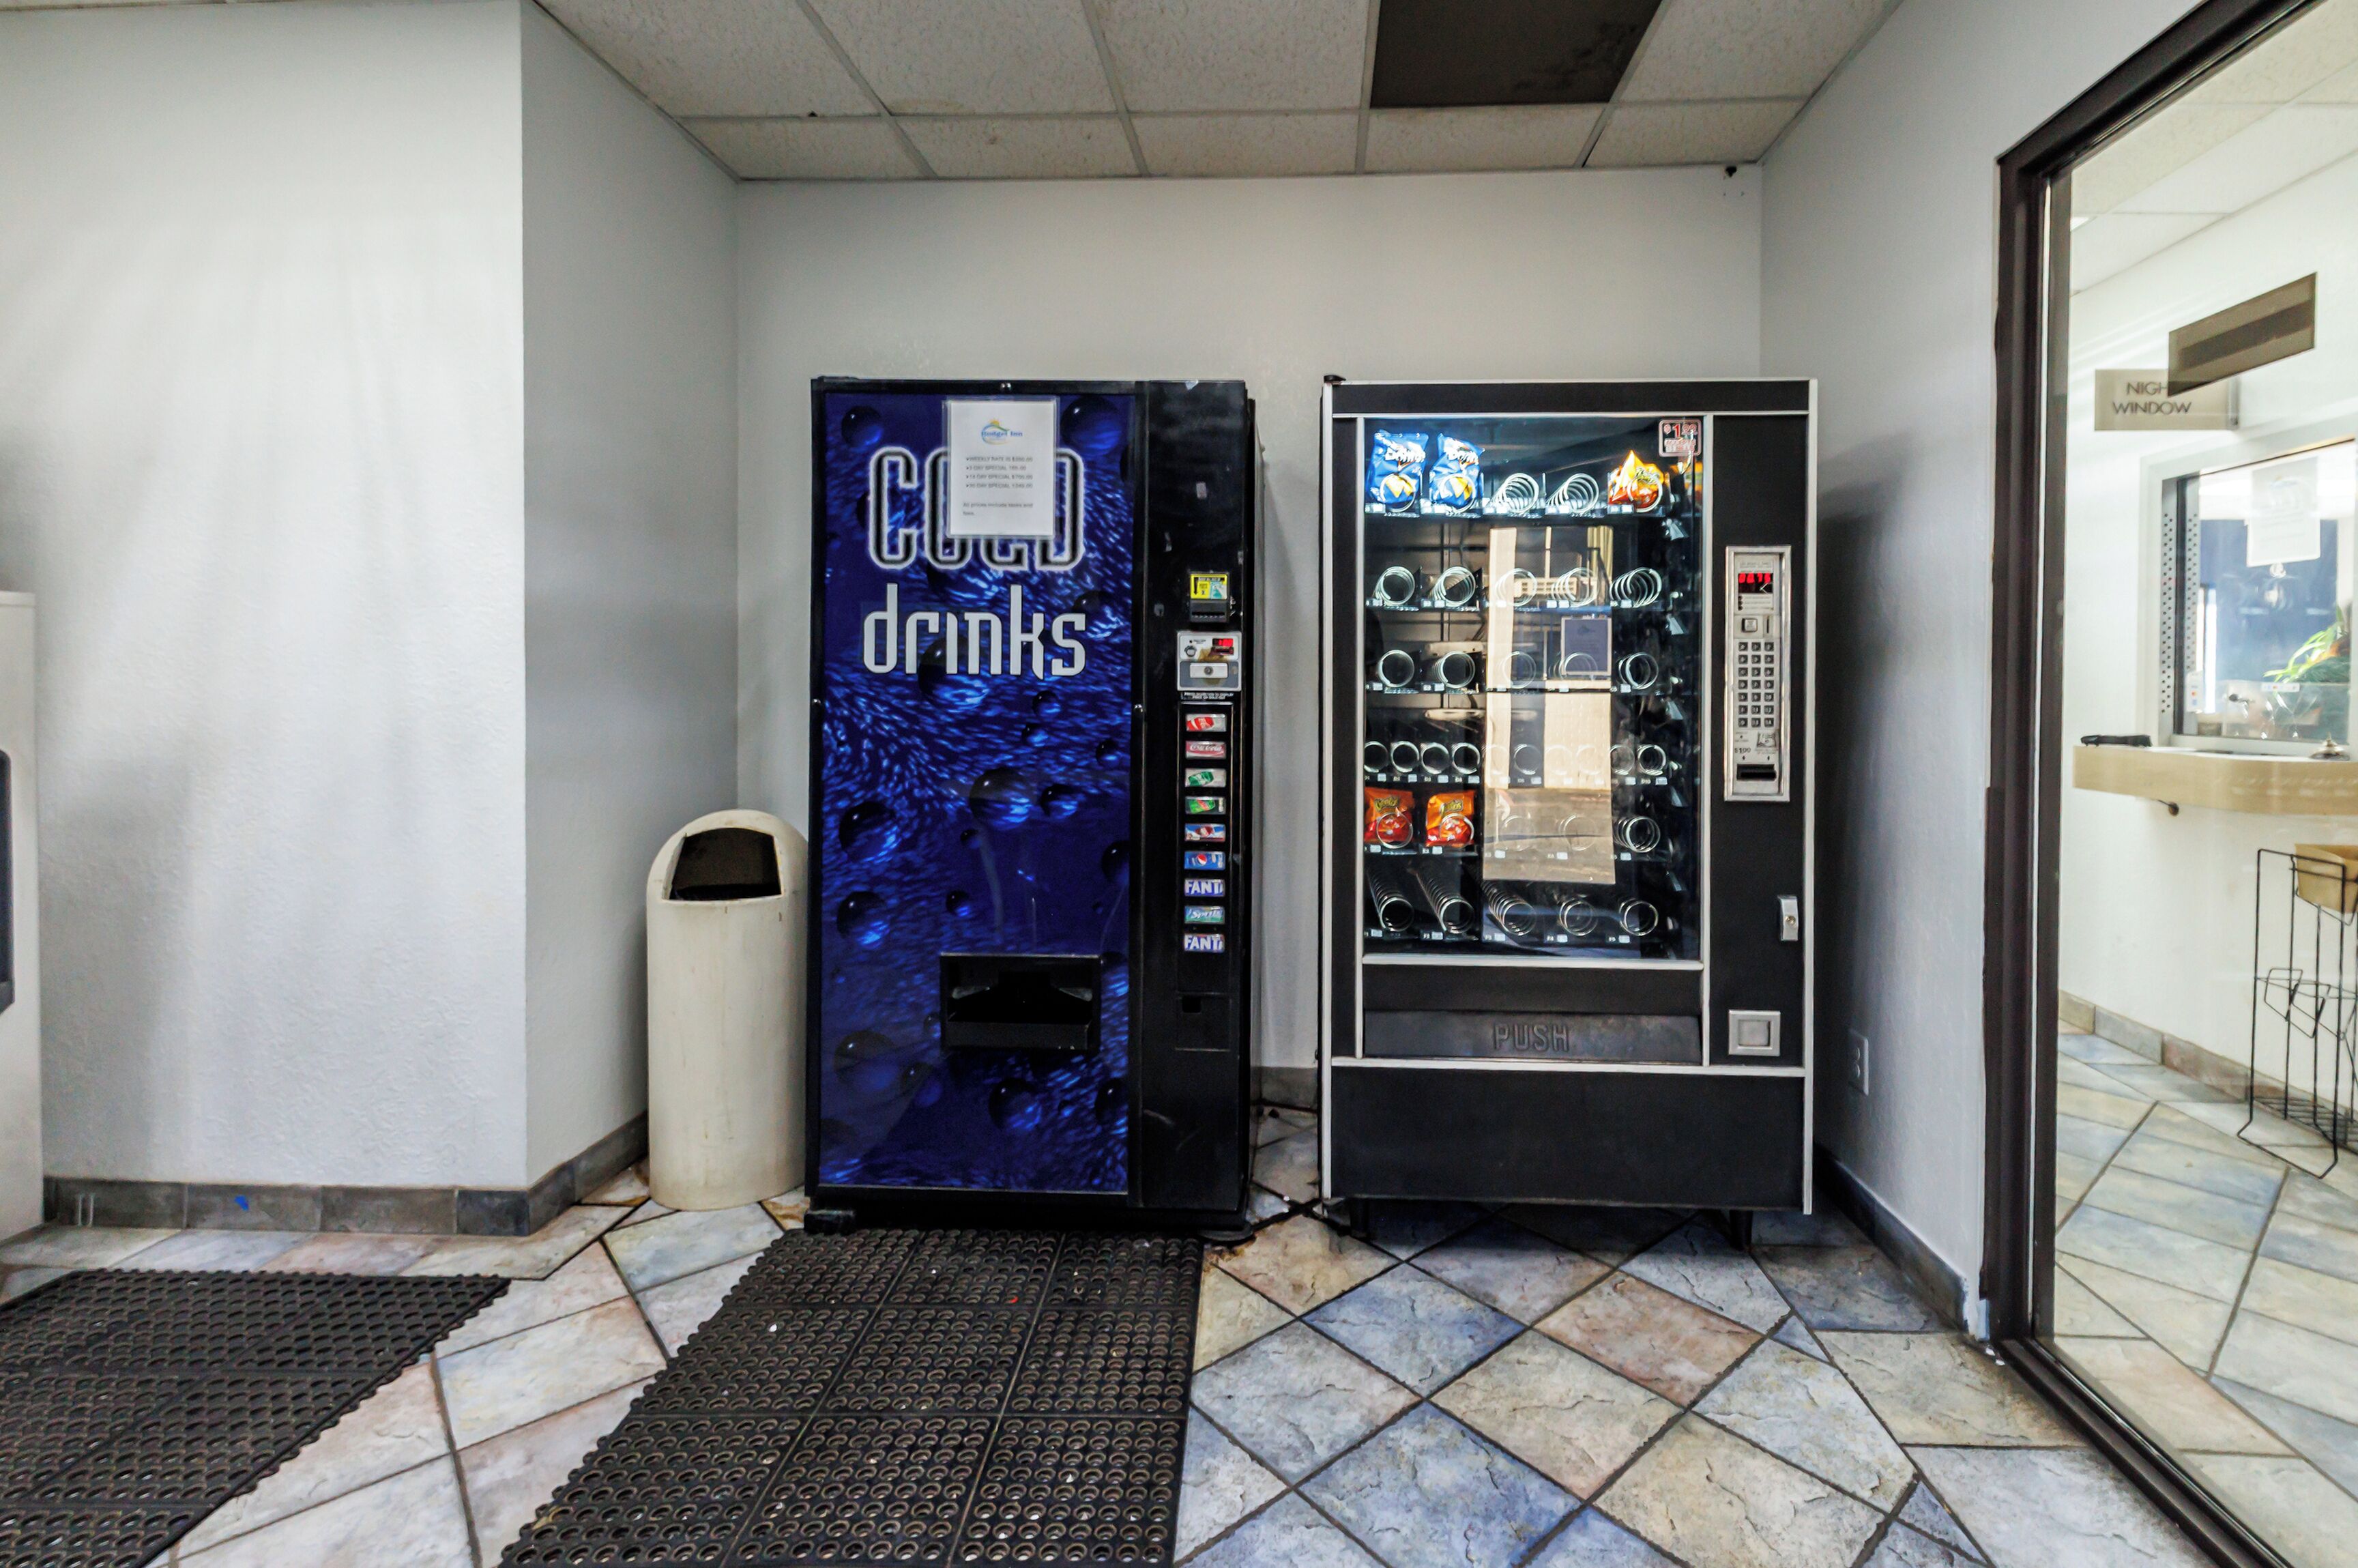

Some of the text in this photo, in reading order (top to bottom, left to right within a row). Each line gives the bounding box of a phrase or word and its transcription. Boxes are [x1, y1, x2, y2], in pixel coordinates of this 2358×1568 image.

[2126, 381, 2168, 396] NIGH
[2112, 401, 2192, 415] WINDOW
[869, 446, 1086, 571] COD
[863, 583, 1086, 680] drinks
[1494, 1023, 1569, 1051] PUSH
